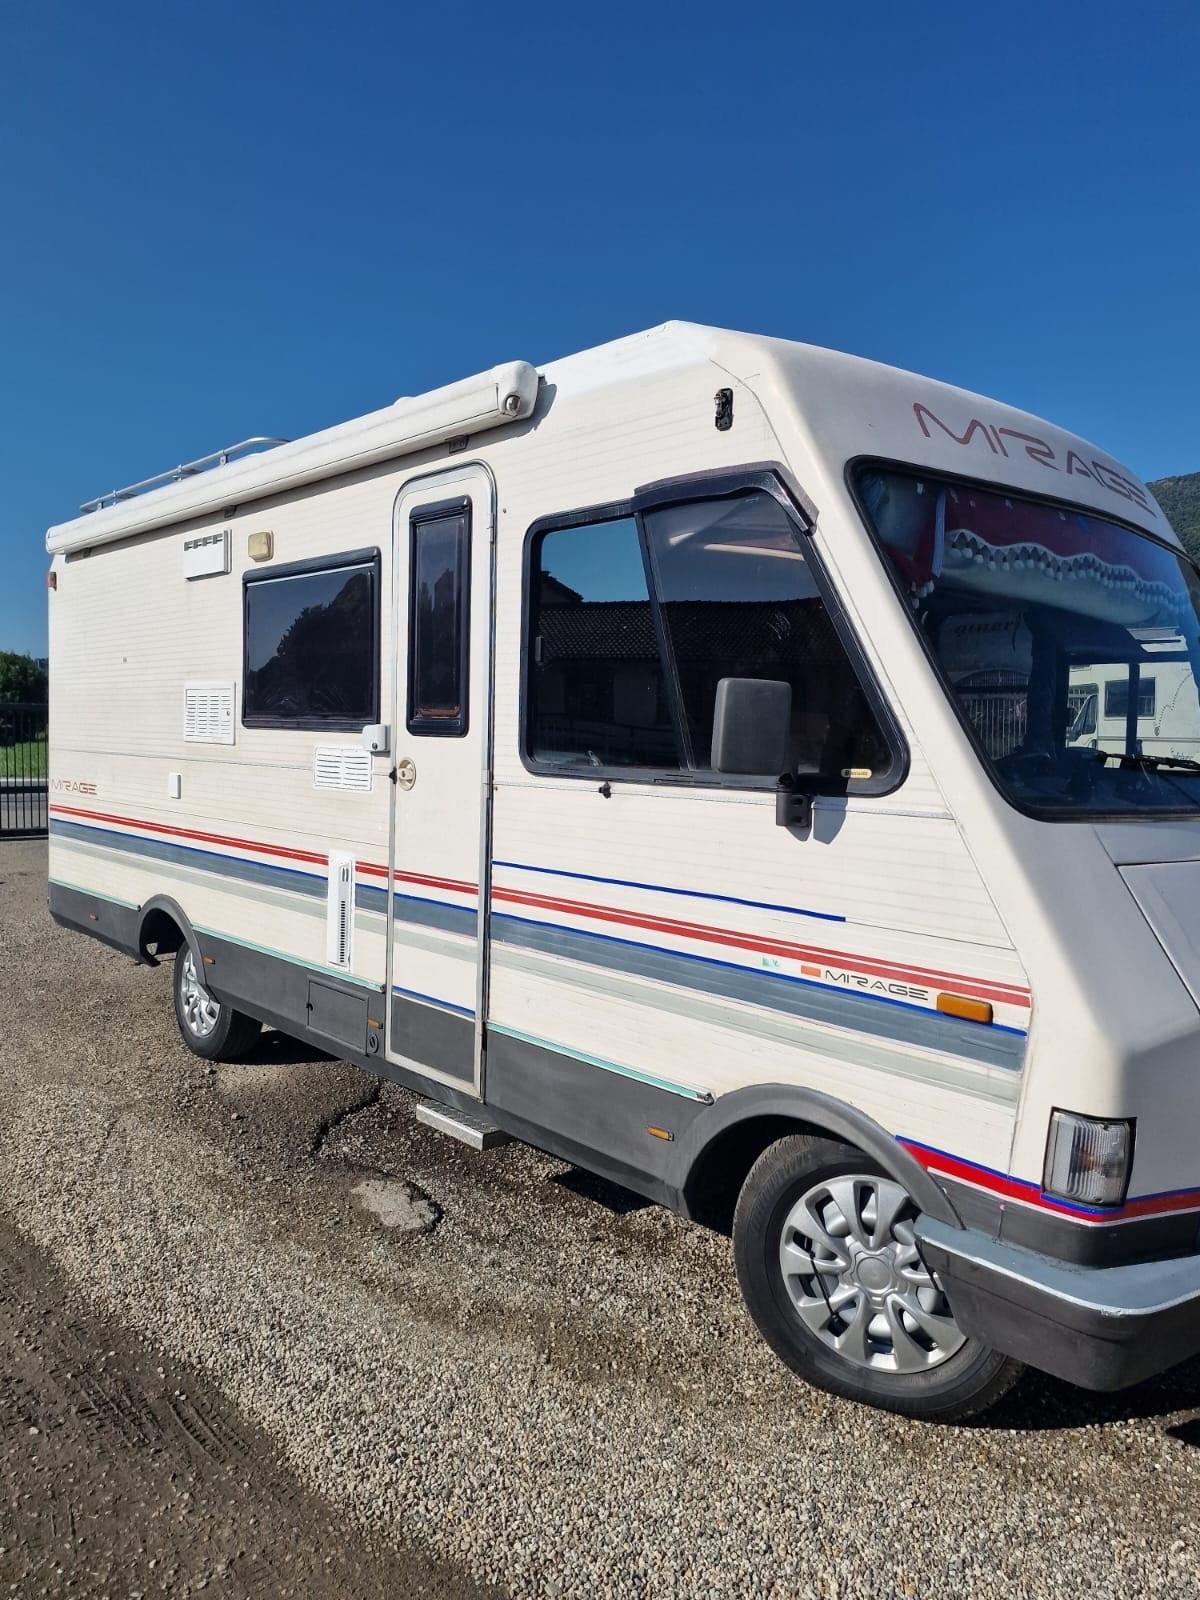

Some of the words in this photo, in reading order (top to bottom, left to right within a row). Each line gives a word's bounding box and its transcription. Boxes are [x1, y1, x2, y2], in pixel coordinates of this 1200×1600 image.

[913, 402, 1157, 519] MIRAGE
[51, 778, 97, 795] MIRAGE
[825, 969, 929, 1001] MIRAGE
